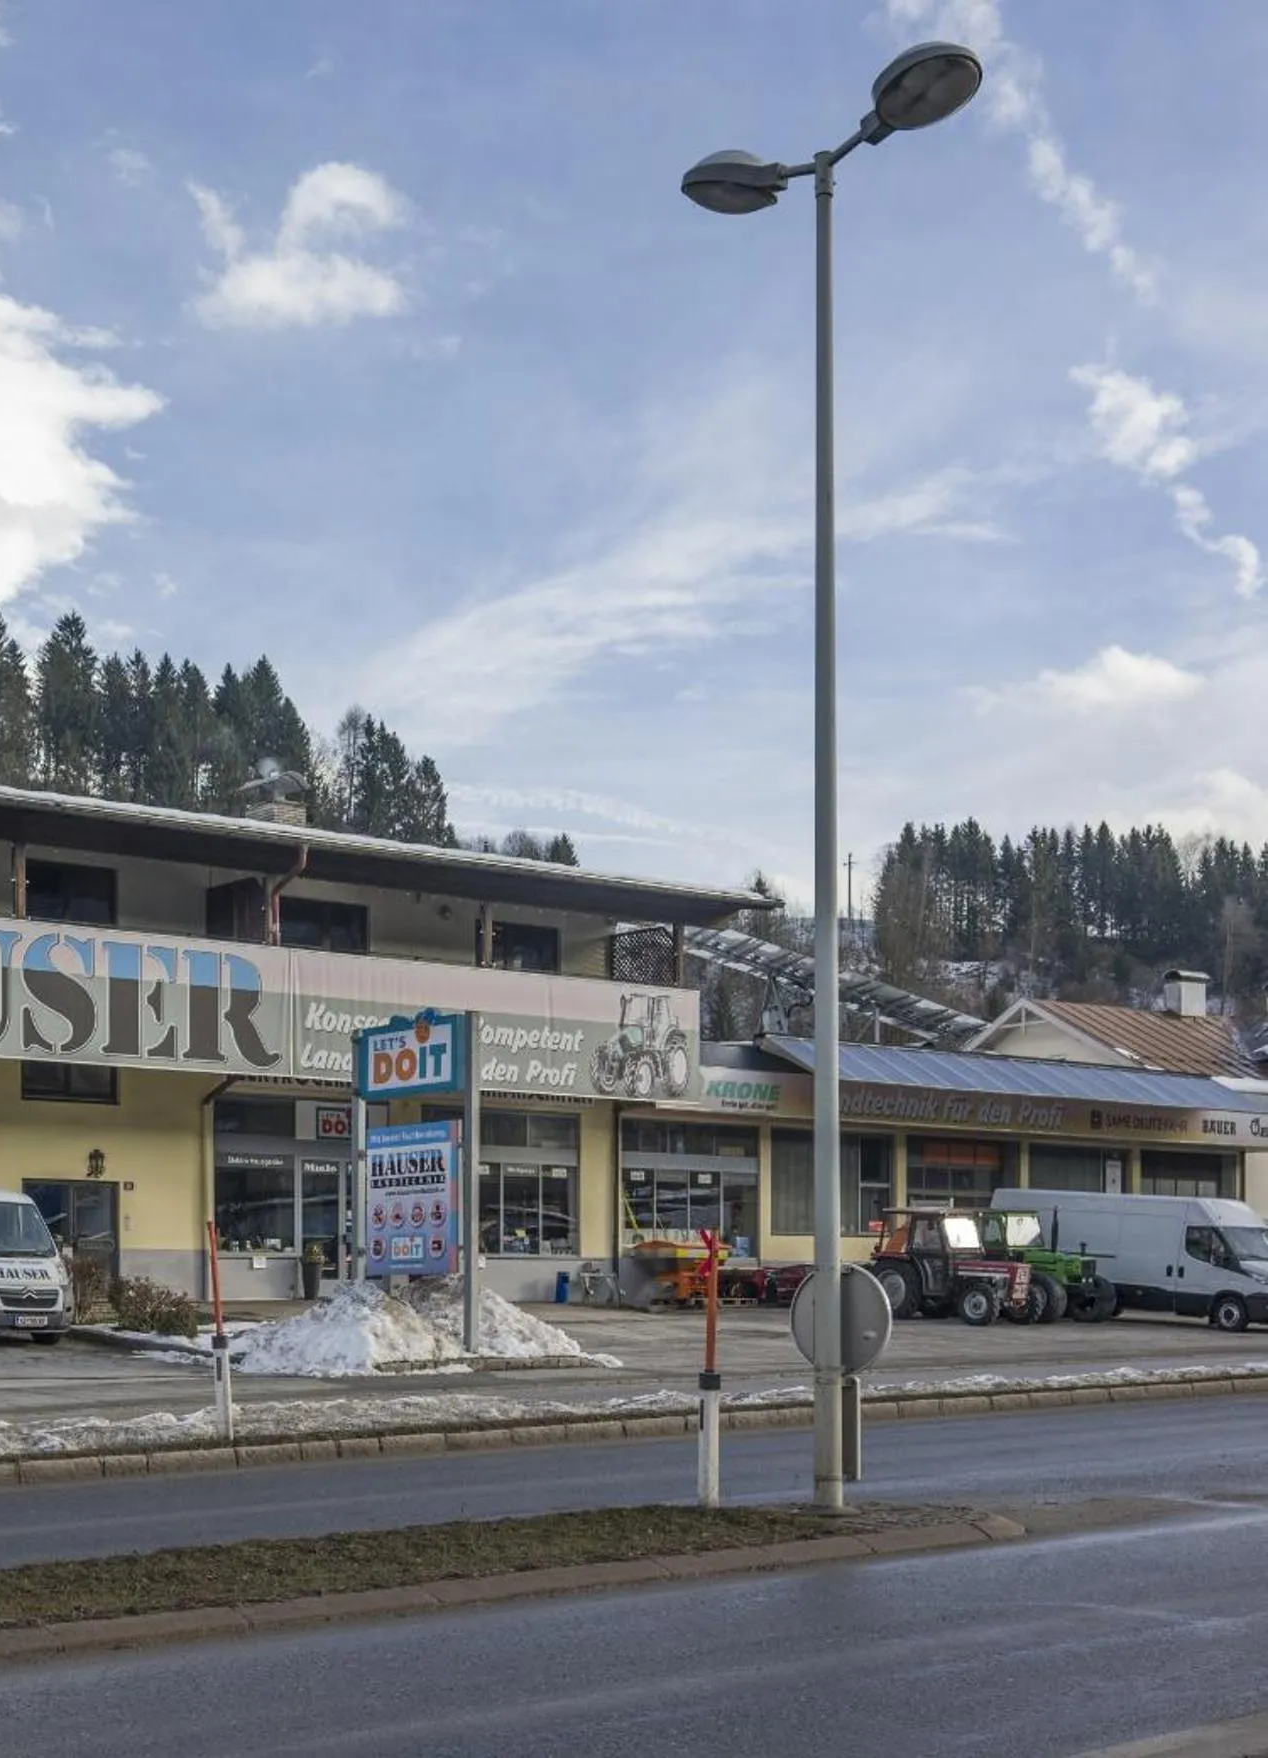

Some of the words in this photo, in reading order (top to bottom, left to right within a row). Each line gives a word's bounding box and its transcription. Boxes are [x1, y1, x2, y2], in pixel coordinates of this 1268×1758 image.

[372, 1035, 407, 1052] LET'S
[479, 1016, 584, 1053] ompetent
[481, 1057, 518, 1083] den
[525, 1058, 579, 1088] Profi
[706, 1080, 782, 1101] KRONE
[839, 1089, 937, 1119] ndtechnik
[942, 1093, 973, 1122] für
[981, 1099, 1013, 1125] den
[1018, 1101, 1066, 1129] Profi
[1201, 1118, 1237, 1136] BAUER
[303, 1161, 338, 1173] Miele
[371, 1148, 446, 1177] HAUSER
